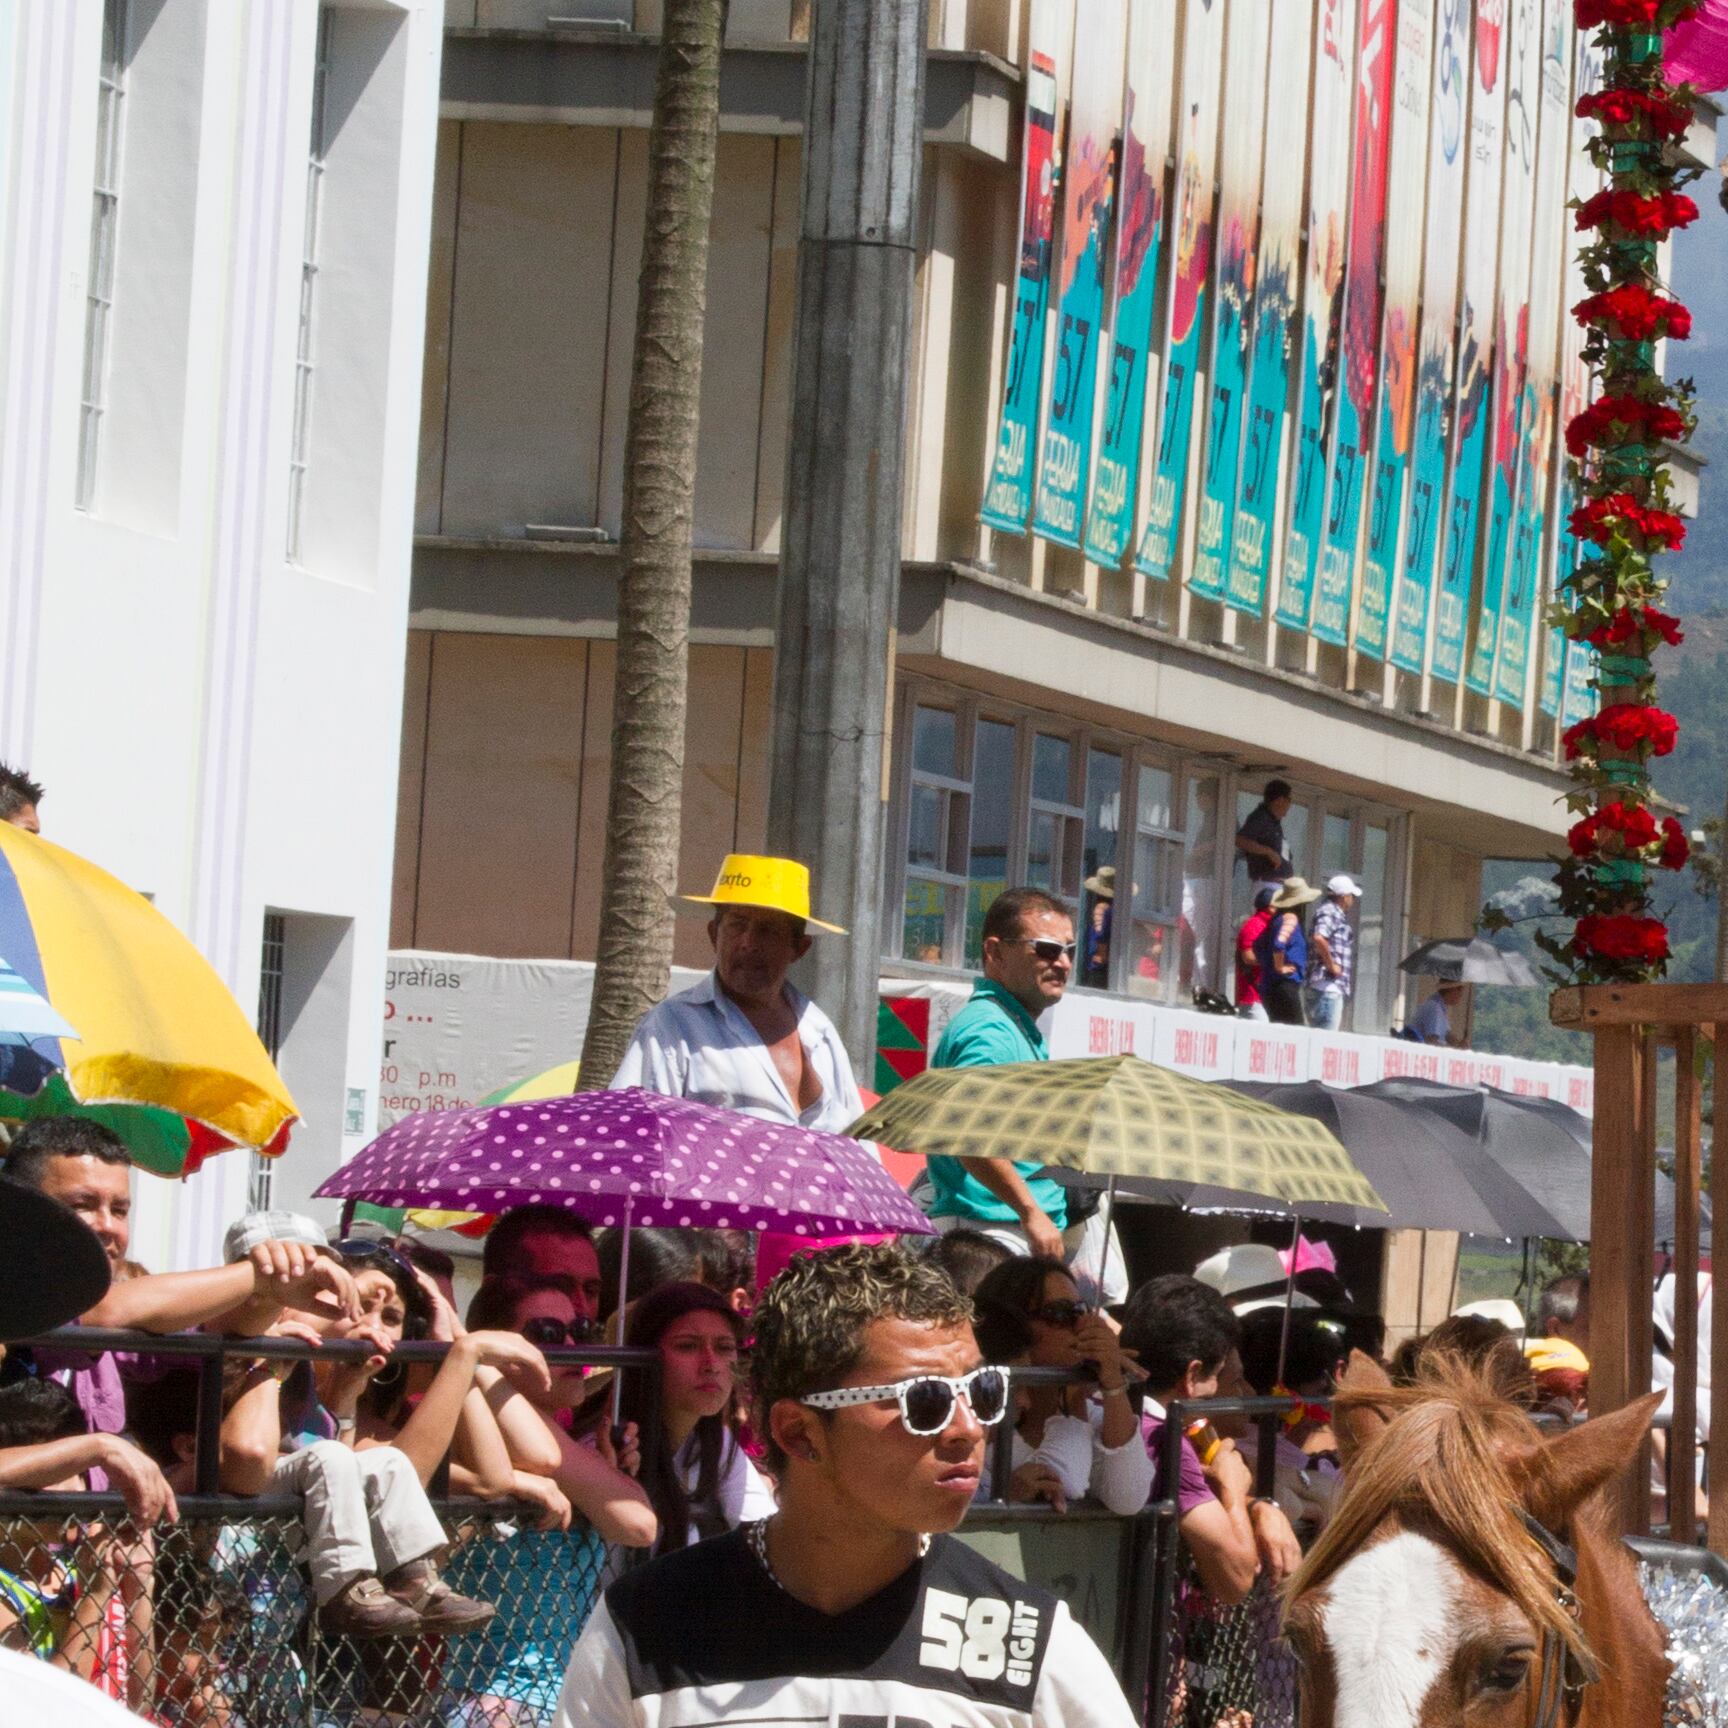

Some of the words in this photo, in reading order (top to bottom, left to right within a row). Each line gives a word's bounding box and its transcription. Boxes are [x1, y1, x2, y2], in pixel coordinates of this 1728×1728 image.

[1054, 313, 1090, 424] 57
[919, 1586, 1012, 1681] 58
[1006, 1599, 1040, 1688] EIGHT
